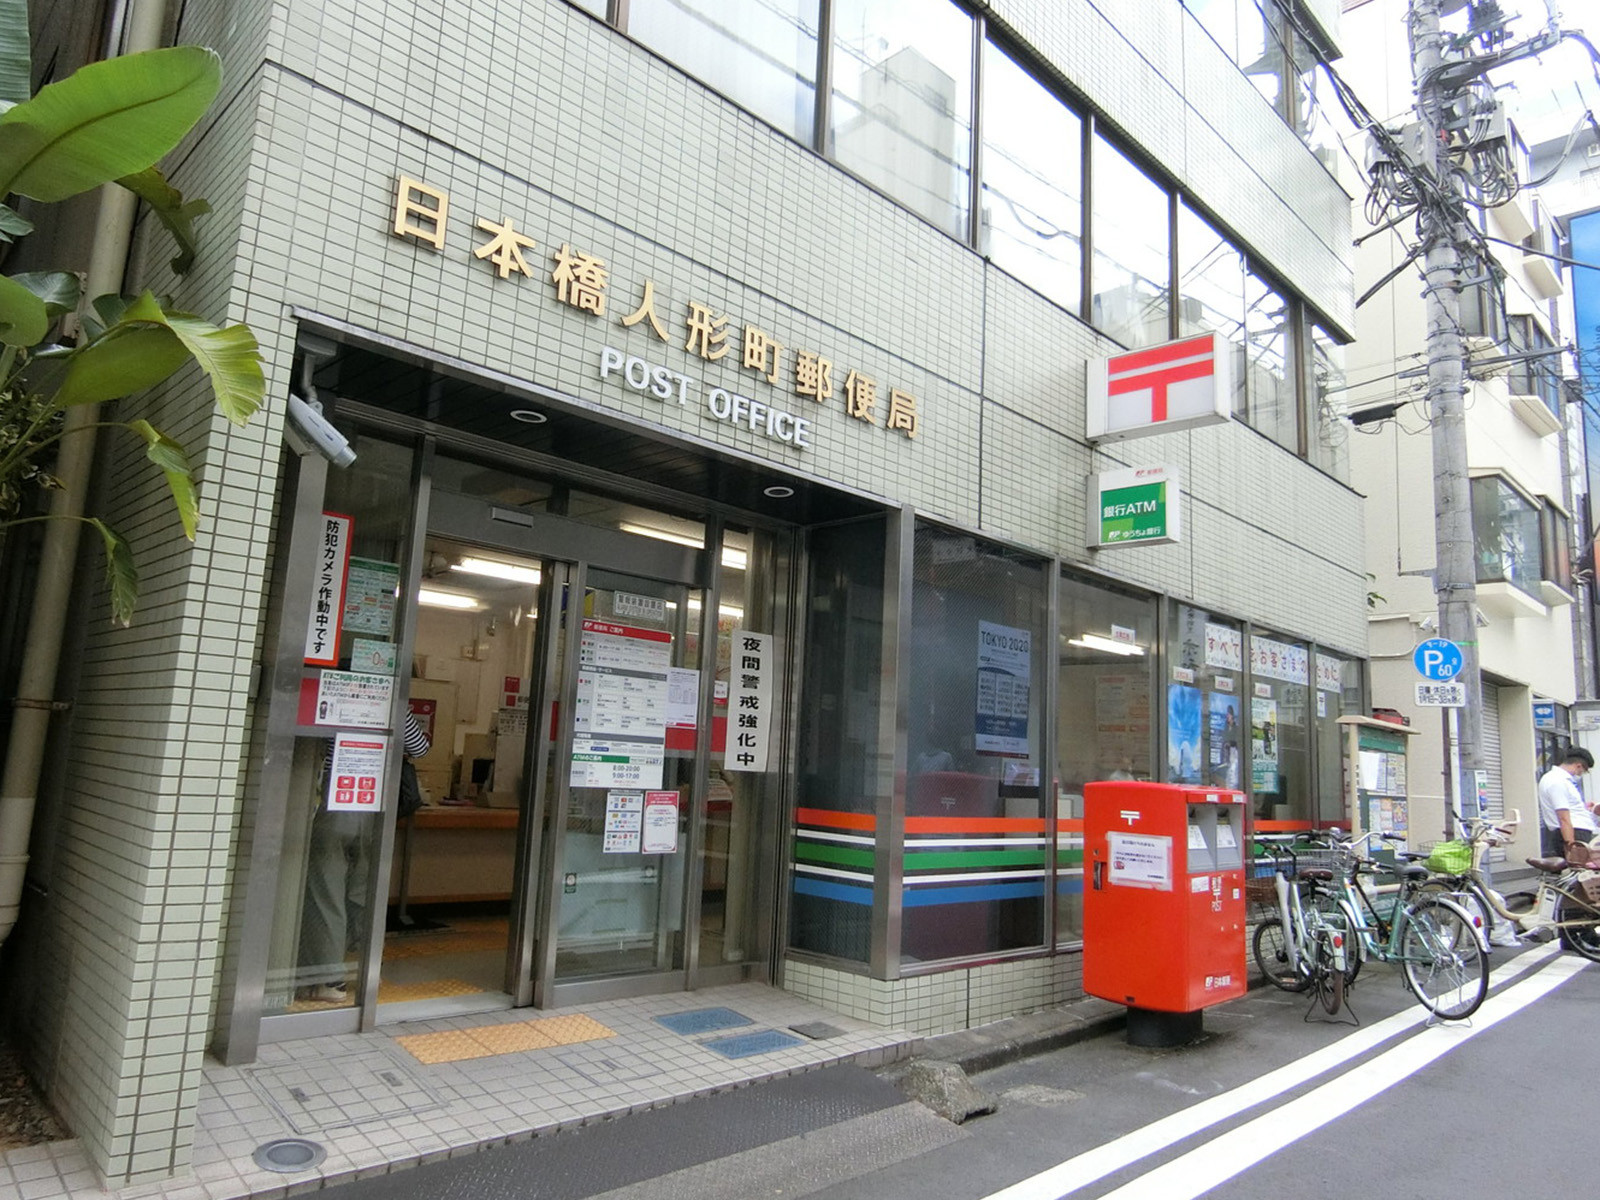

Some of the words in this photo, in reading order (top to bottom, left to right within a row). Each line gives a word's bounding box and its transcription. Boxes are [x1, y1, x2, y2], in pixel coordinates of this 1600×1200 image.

[394, 174, 920, 440] 日本橋人形町郵便局
[600, 346, 694, 406] POST
[708, 388, 811, 448] OFFICE
[1103, 500, 1157, 518] 銀行ATM
[1122, 526, 1161, 538] ゆうちょ銀行
[313, 520, 340, 654] 防犯カメラ作動中です
[981, 631, 1008, 649] TOKYO
[1009, 638, 1029, 653] 2020
[1208, 637, 1240, 659] すべて
[1424, 650, 1444, 677] P
[1438, 664, 1453, 677] 60
[737, 637, 762, 766] 夜間警戒強化中
